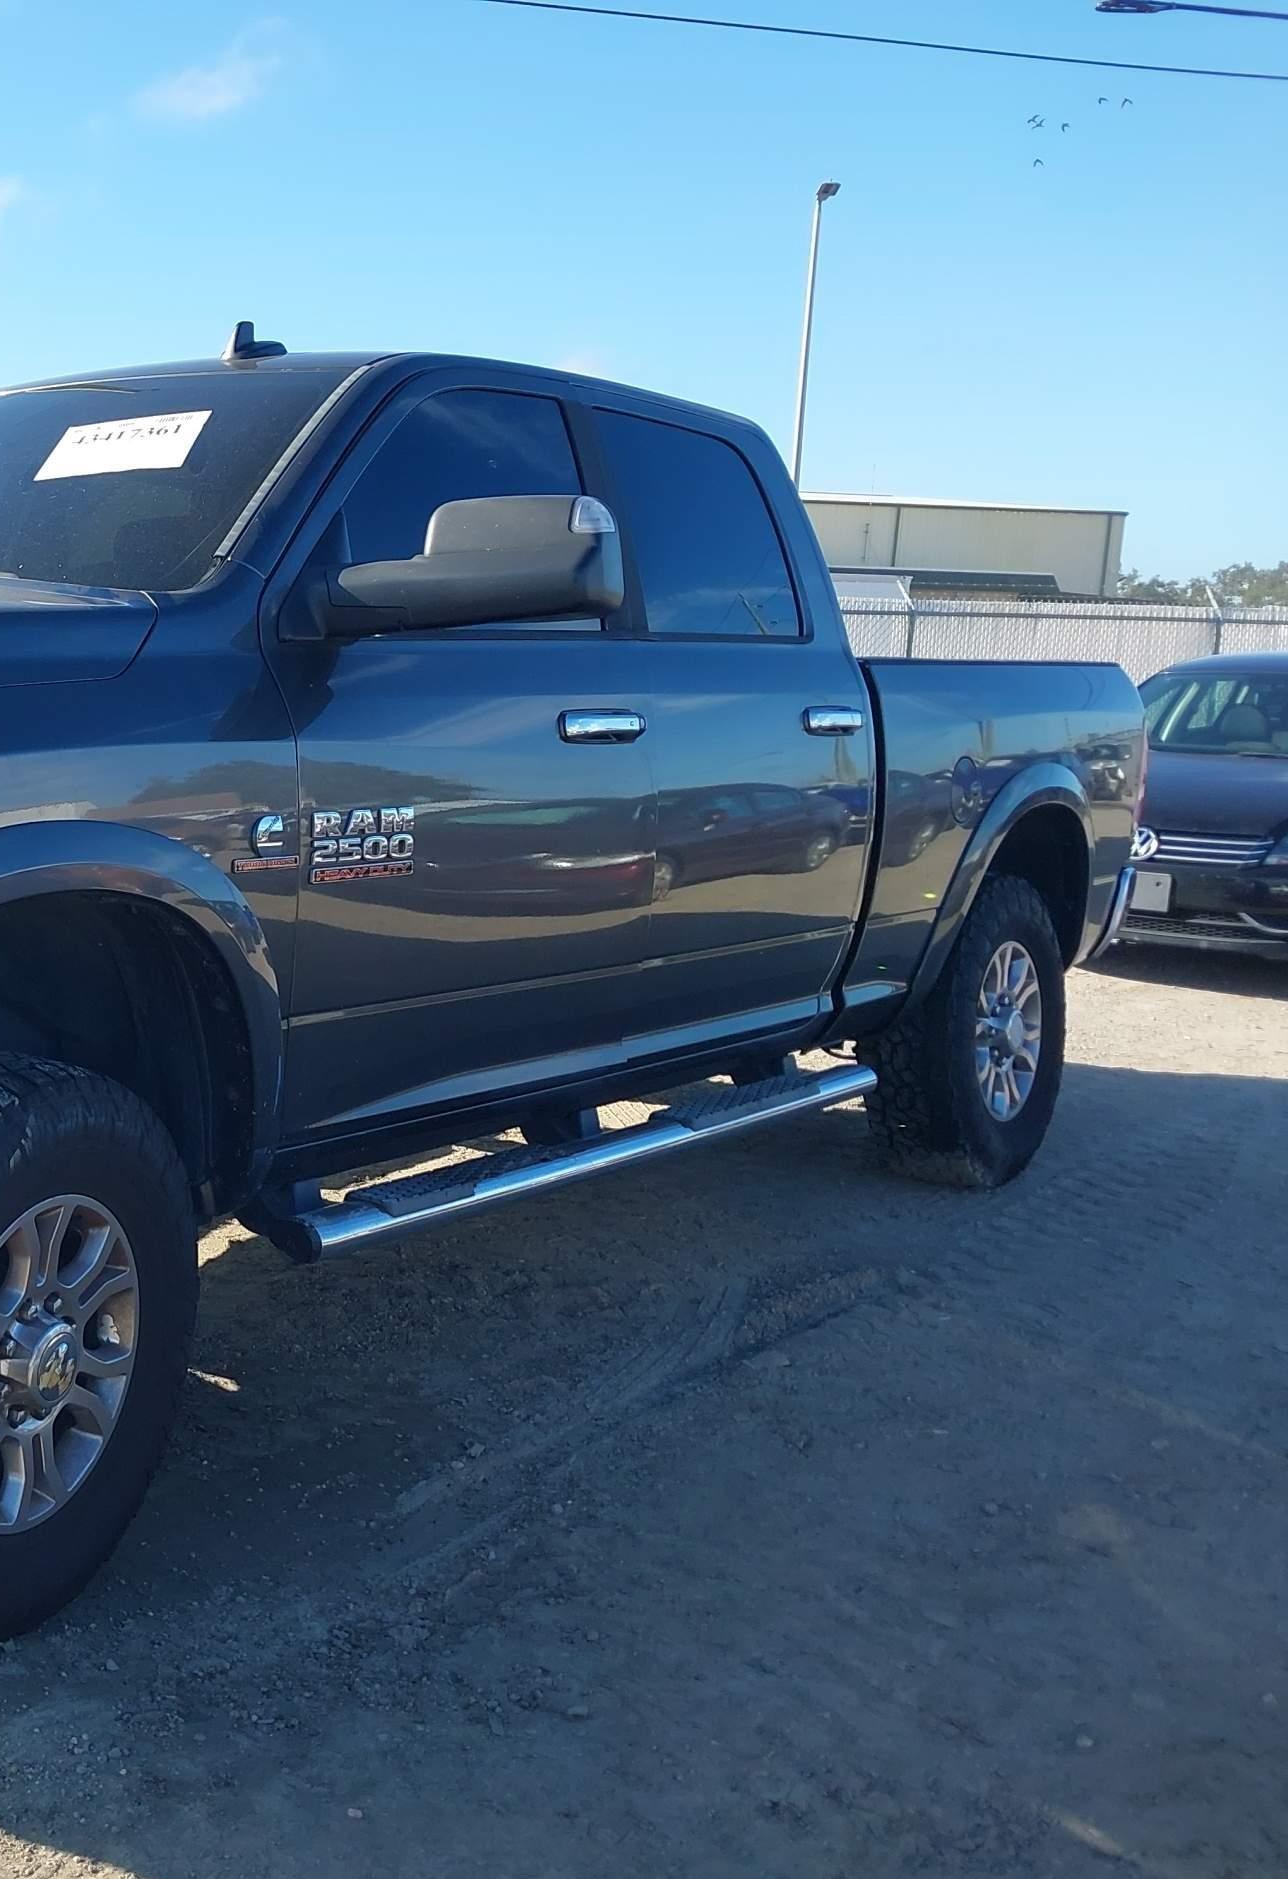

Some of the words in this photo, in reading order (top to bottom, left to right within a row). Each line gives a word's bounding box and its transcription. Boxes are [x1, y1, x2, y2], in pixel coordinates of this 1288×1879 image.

[312, 807, 414, 838] RAM
[312, 833, 414, 864] 2500
[316, 867, 368, 881] HEAVY
[369, 862, 411, 877] DUTY
